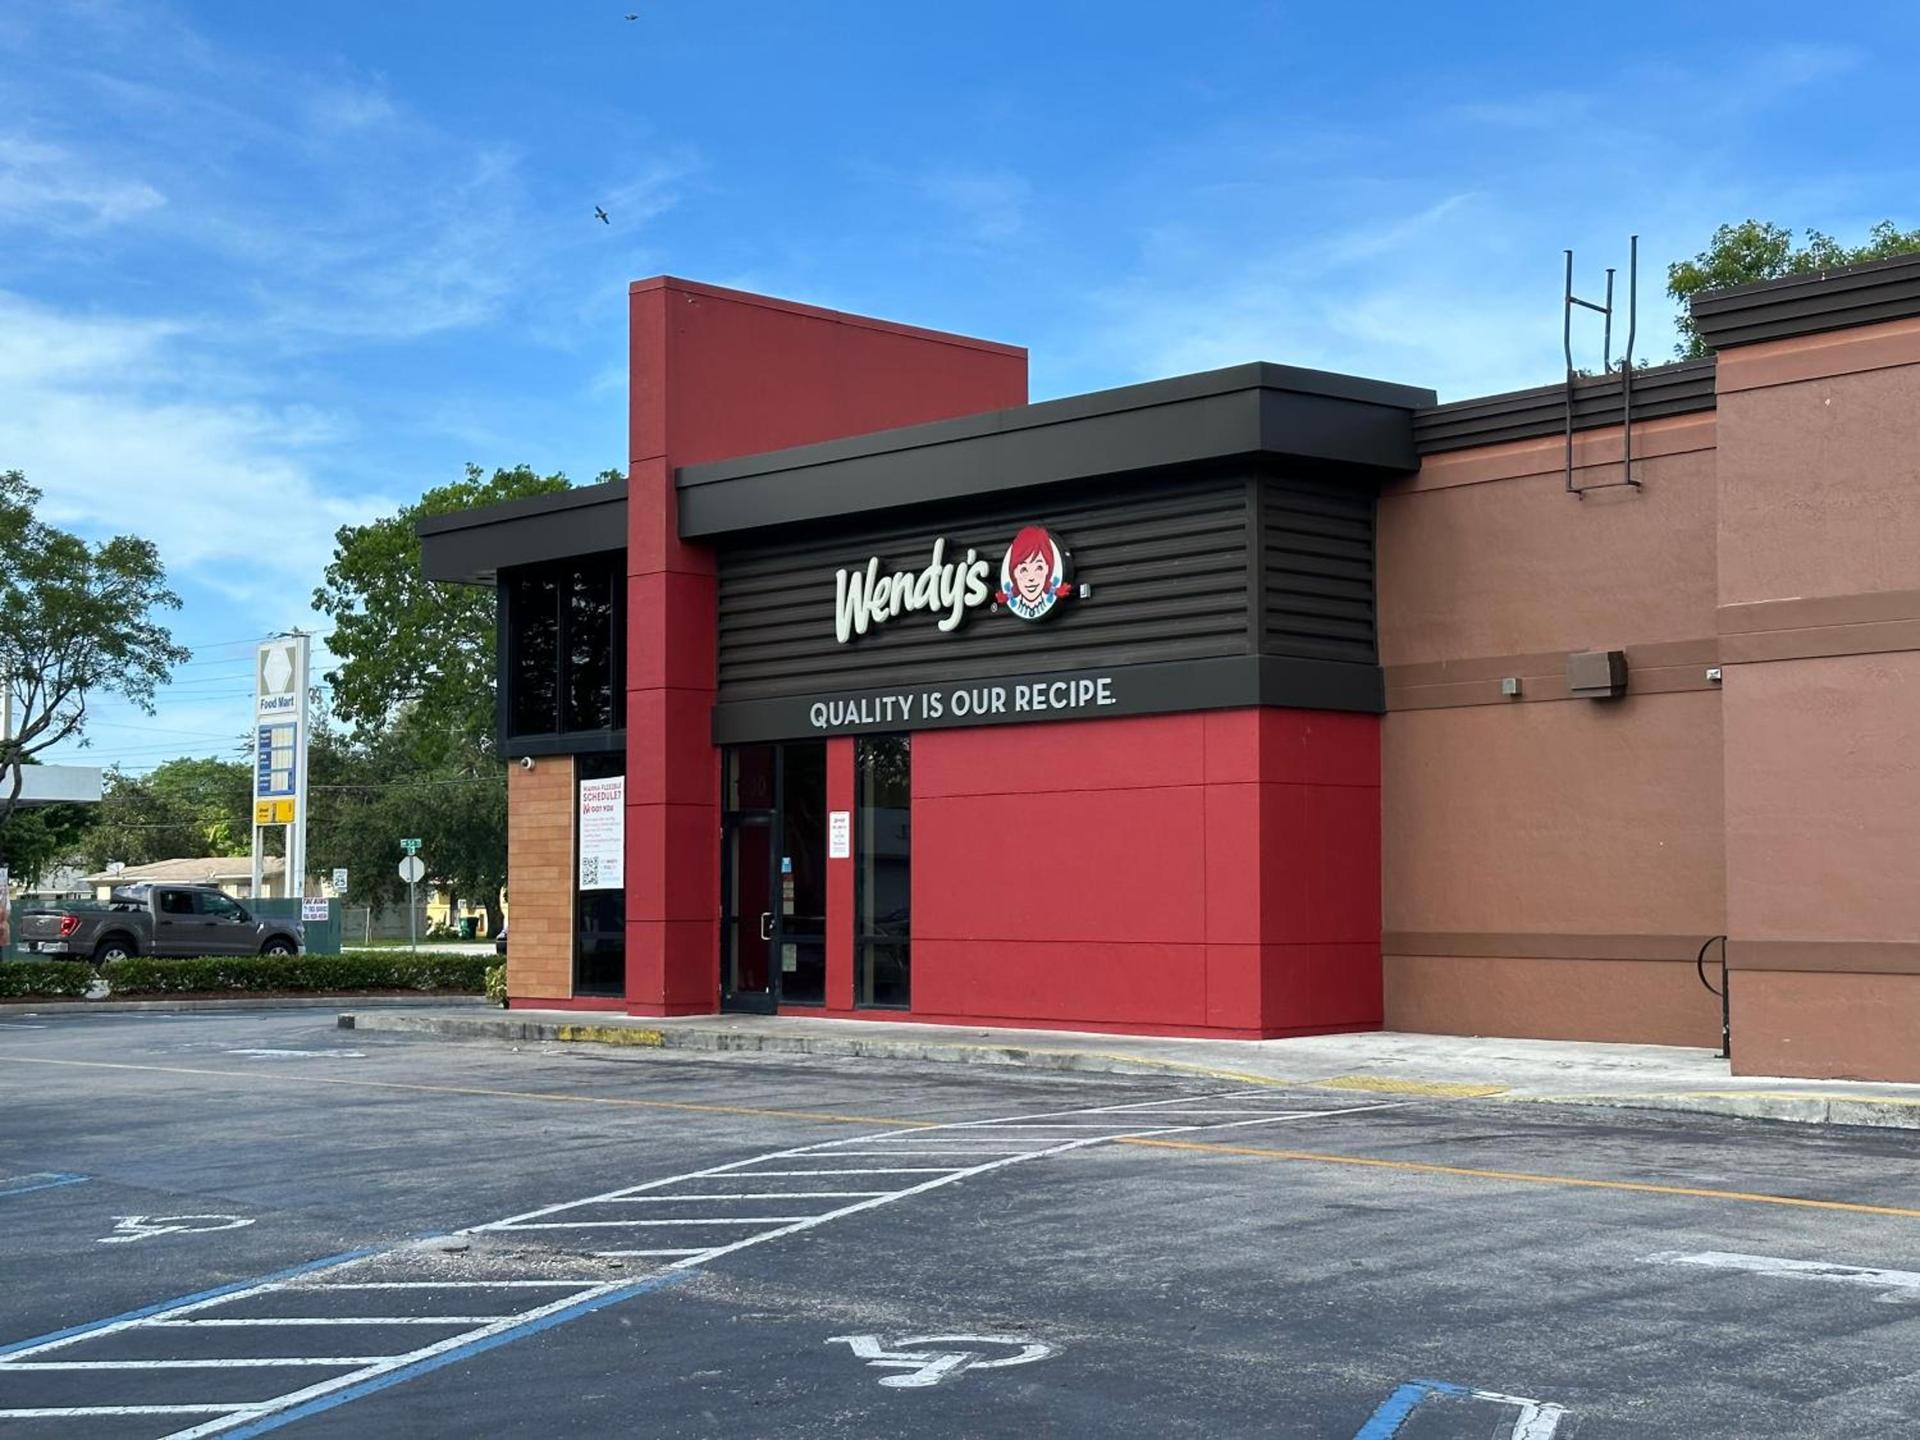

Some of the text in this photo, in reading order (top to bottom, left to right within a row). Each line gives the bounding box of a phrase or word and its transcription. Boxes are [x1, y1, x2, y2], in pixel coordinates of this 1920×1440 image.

[835, 537, 990, 644] Wendy's
[260, 695, 294, 709] Food Mart
[810, 677, 1117, 729] QUALITY IS OUR RECIPE.
[583, 790, 622, 802] SCHEDULE?
